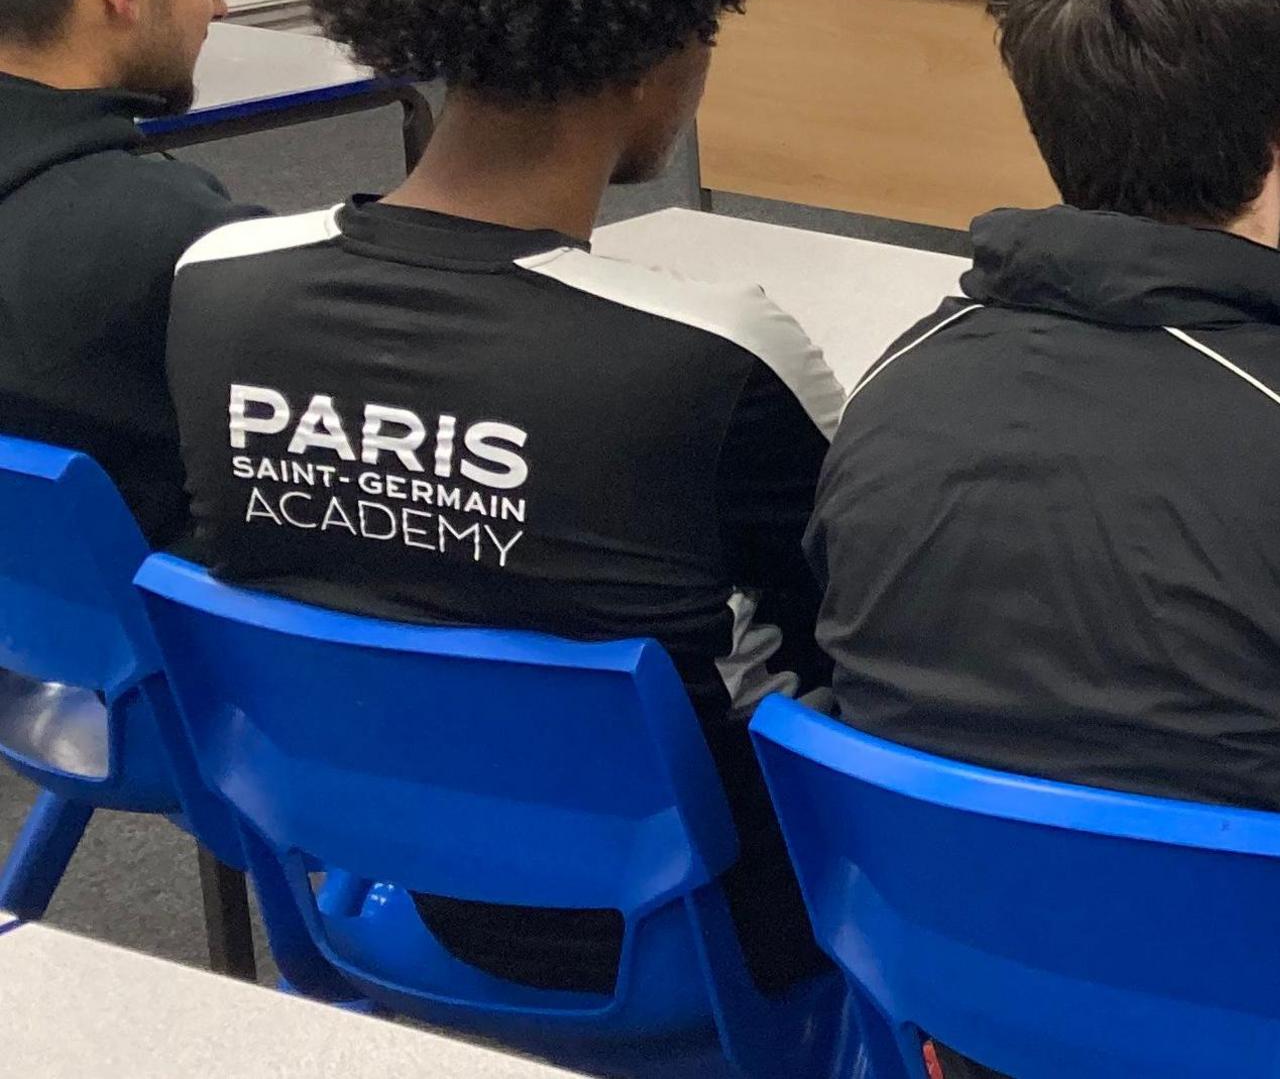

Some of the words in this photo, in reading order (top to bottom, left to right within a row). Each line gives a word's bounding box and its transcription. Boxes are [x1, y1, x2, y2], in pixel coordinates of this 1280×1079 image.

[229, 384, 529, 490] PARIS
[232, 456, 527, 523] SAINT-GERMAIN
[245, 486, 524, 567] ACADEMY
